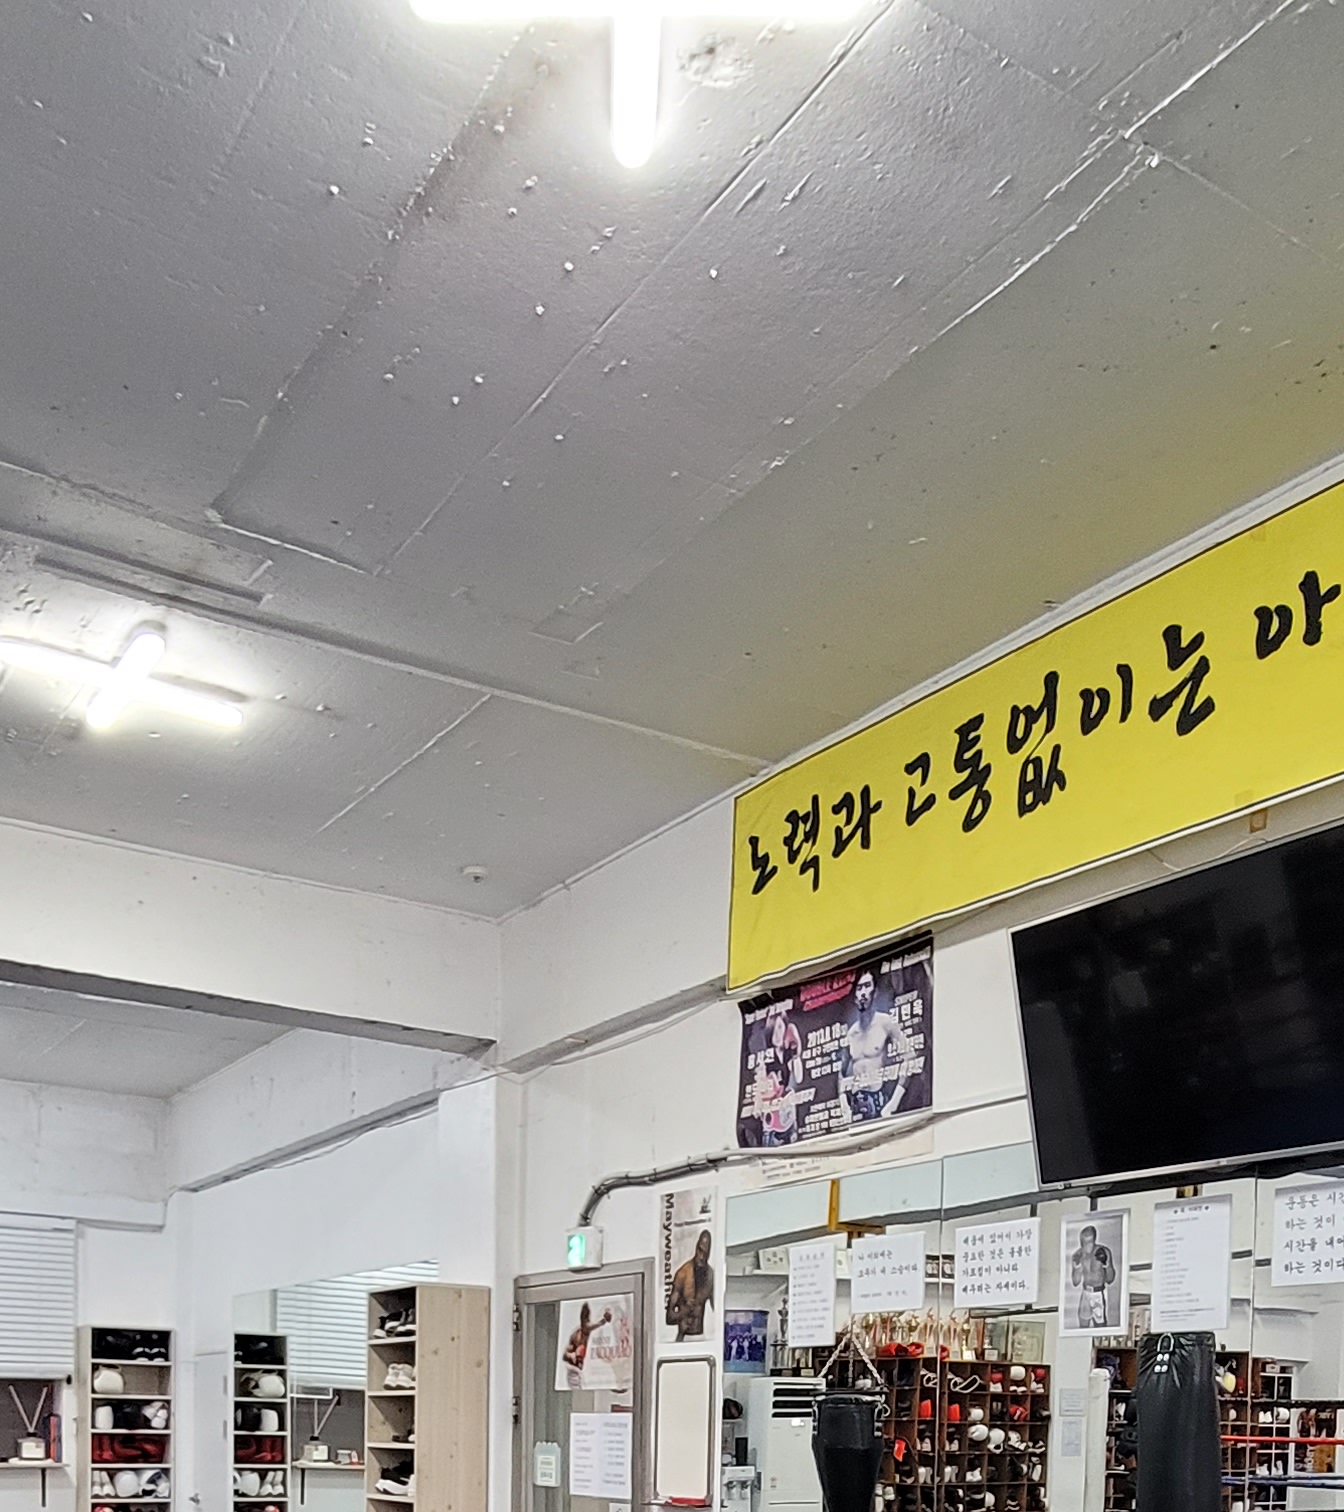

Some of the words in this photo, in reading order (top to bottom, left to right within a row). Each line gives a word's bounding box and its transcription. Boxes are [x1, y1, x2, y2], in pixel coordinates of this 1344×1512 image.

[749, 785, 882, 894] 노력과
[1285, 1194, 1319, 1210] 운동은
[1285, 1217, 1307, 1231] 하는
[1314, 1213, 1336, 1228] 것이
[1284, 1236, 1317, 1252] 시간을
[1284, 1261, 1305, 1274] 하는
